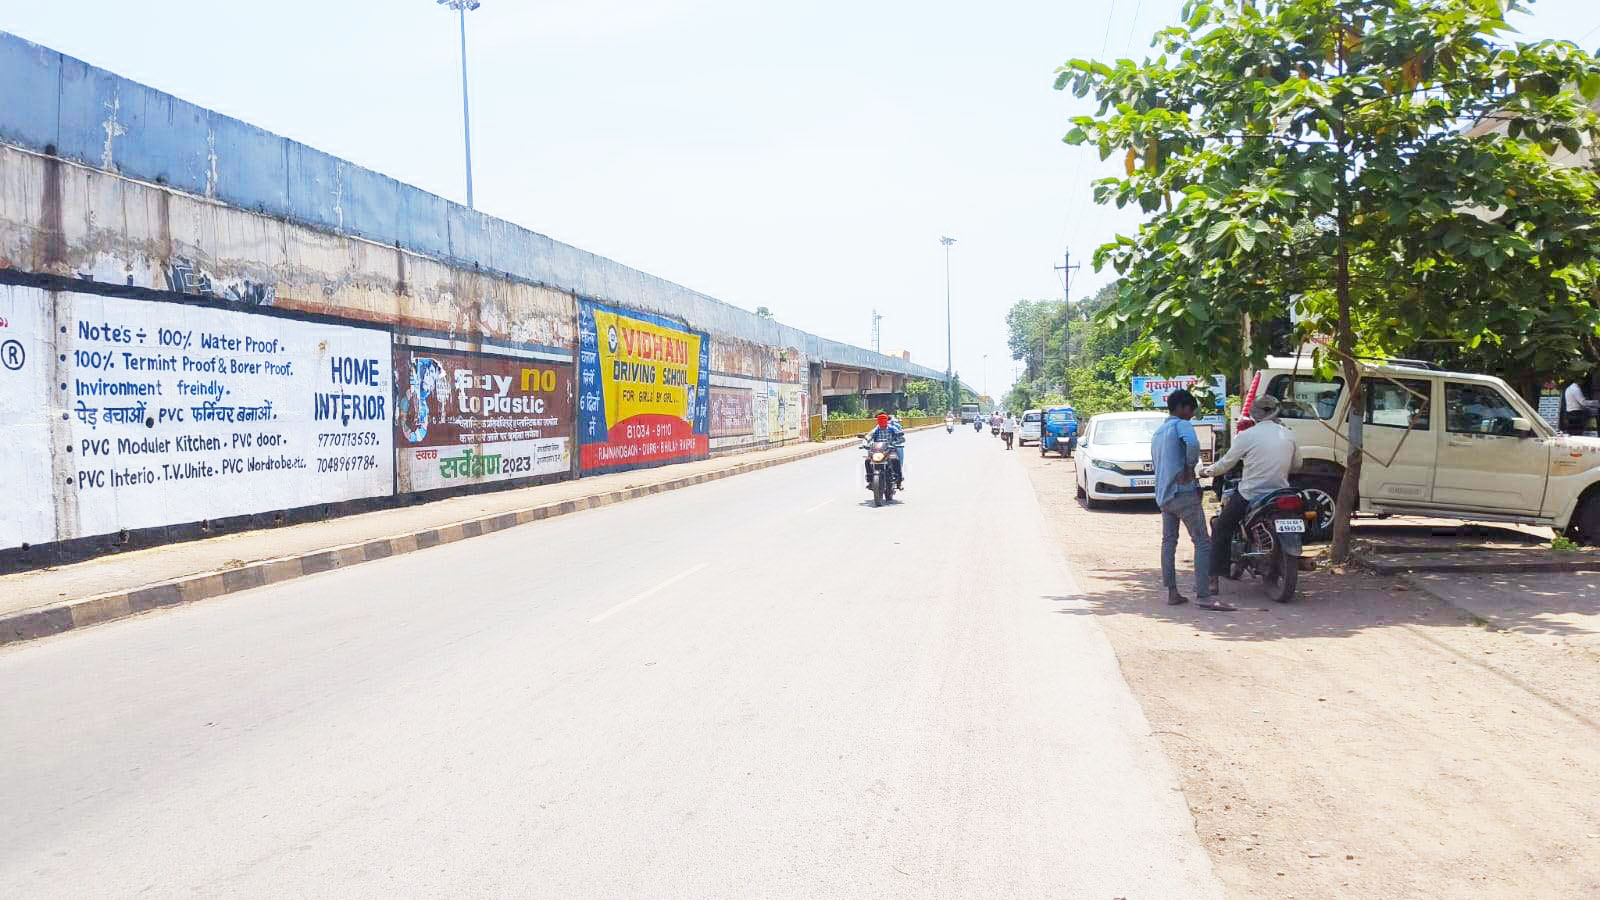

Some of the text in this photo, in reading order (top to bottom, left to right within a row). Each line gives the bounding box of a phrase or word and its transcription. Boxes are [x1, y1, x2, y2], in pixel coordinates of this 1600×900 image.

[158, 328, 192, 350] 100%
[201, 333, 242, 351] Water
[245, 336, 285, 353] Proof.
[74, 350, 115, 371] 100%
[122, 352, 177, 372] Termint
[183, 356, 216, 373] Proof
[230, 359, 261, 374] Borer
[264, 360, 294, 376] Proof.
[331, 356, 380, 386] HOME
[613, 360, 688, 385] DRIVING SCHOOL
[75, 378, 231, 401] Invironment freindly.
[521, 368, 557, 392] no
[314, 392, 385, 422] INTERIOR
[458, 393, 544, 416] to plastic
[622, 389, 635, 402] FOR
[74, 400, 98, 430] पेड़
[159, 408, 184, 423] PVC
[82, 439, 110, 456] PVC
[118, 437, 171, 455] Moduler
[232, 433, 252, 449] PVC
[256, 432, 287, 447] door.
[78, 470, 105, 489] PVC
[222, 458, 244, 475] PVC
[439, 449, 502, 479] सर्वेक्षण
[502, 456, 531, 474] 2023
